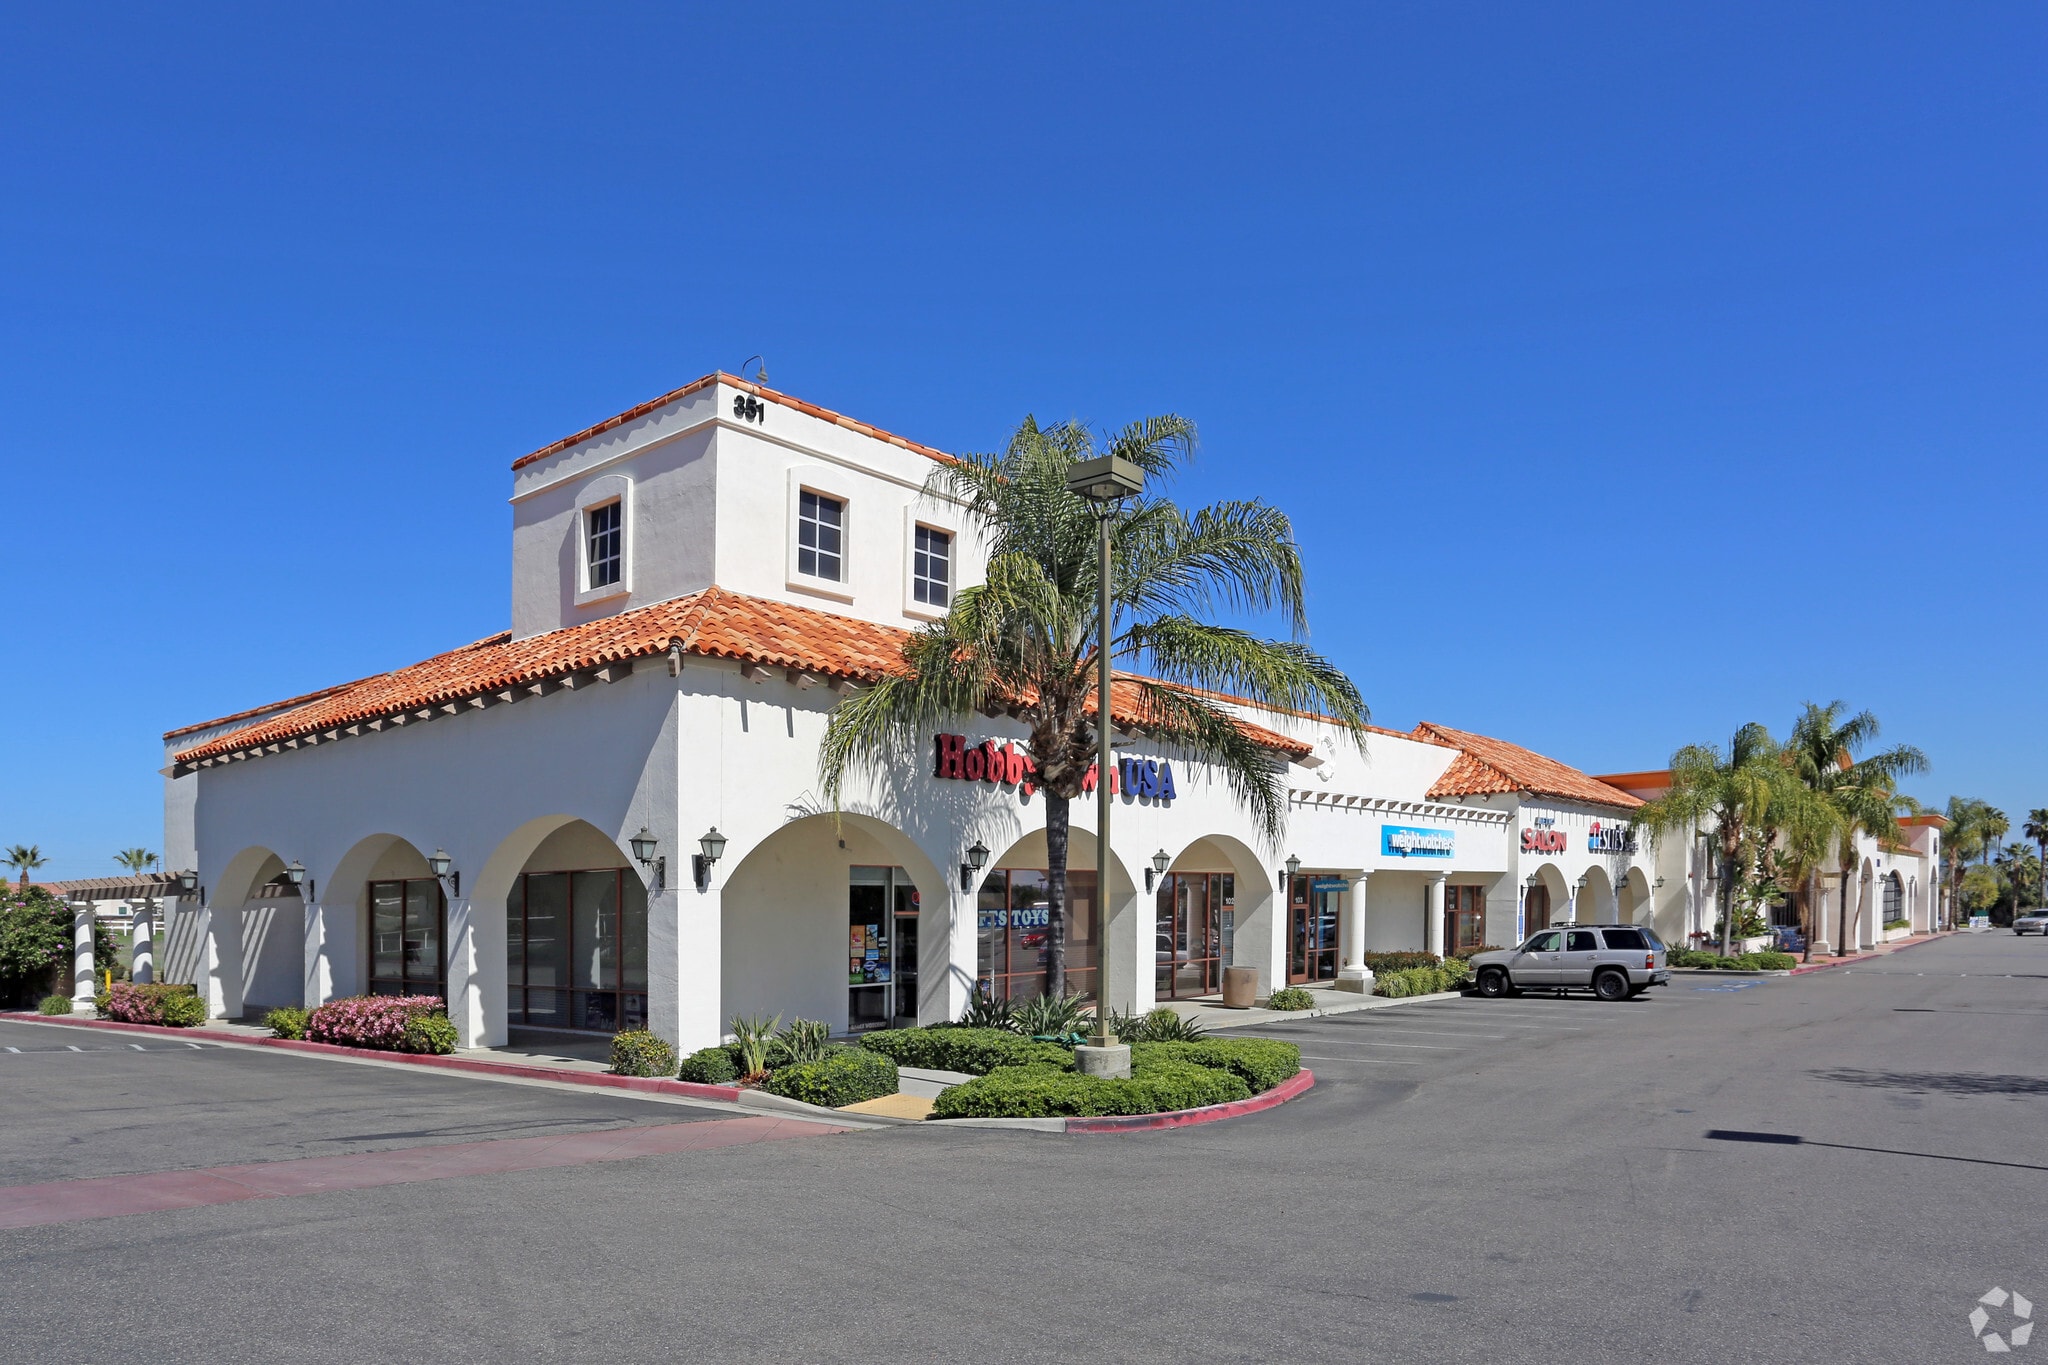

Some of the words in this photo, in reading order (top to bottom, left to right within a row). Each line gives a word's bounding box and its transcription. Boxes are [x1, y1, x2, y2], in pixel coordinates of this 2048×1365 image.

[734, 395, 764, 424] 351
[1124, 757, 1177, 800] USA
[1391, 829, 1454, 853] weightwatchers
[1523, 827, 1568, 852] SALON
[1592, 825, 1624, 851] LESLIE'S
[1011, 909, 1049, 926] TOYS
